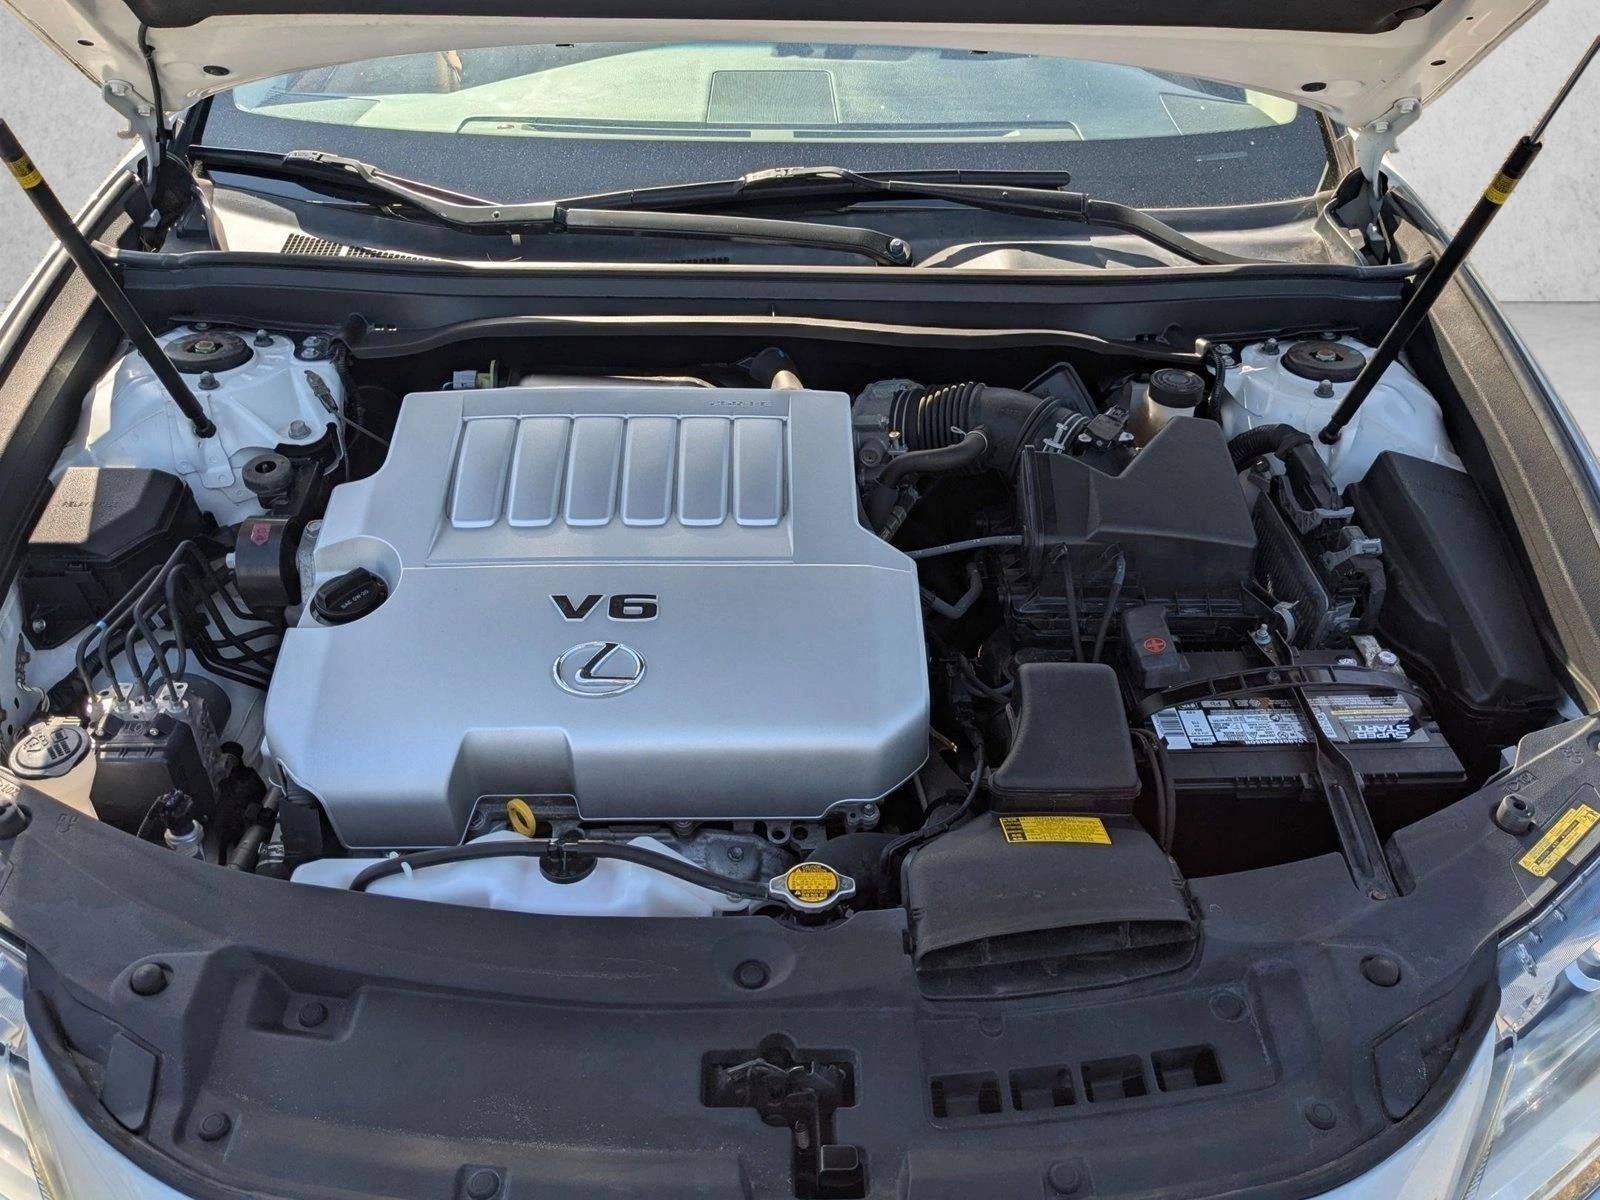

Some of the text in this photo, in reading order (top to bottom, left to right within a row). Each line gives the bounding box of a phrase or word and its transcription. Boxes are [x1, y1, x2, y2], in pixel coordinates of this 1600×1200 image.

[549, 593, 659, 622] V6
[1354, 724, 1411, 732] START
[1356, 731, 1409, 739] SUPER
